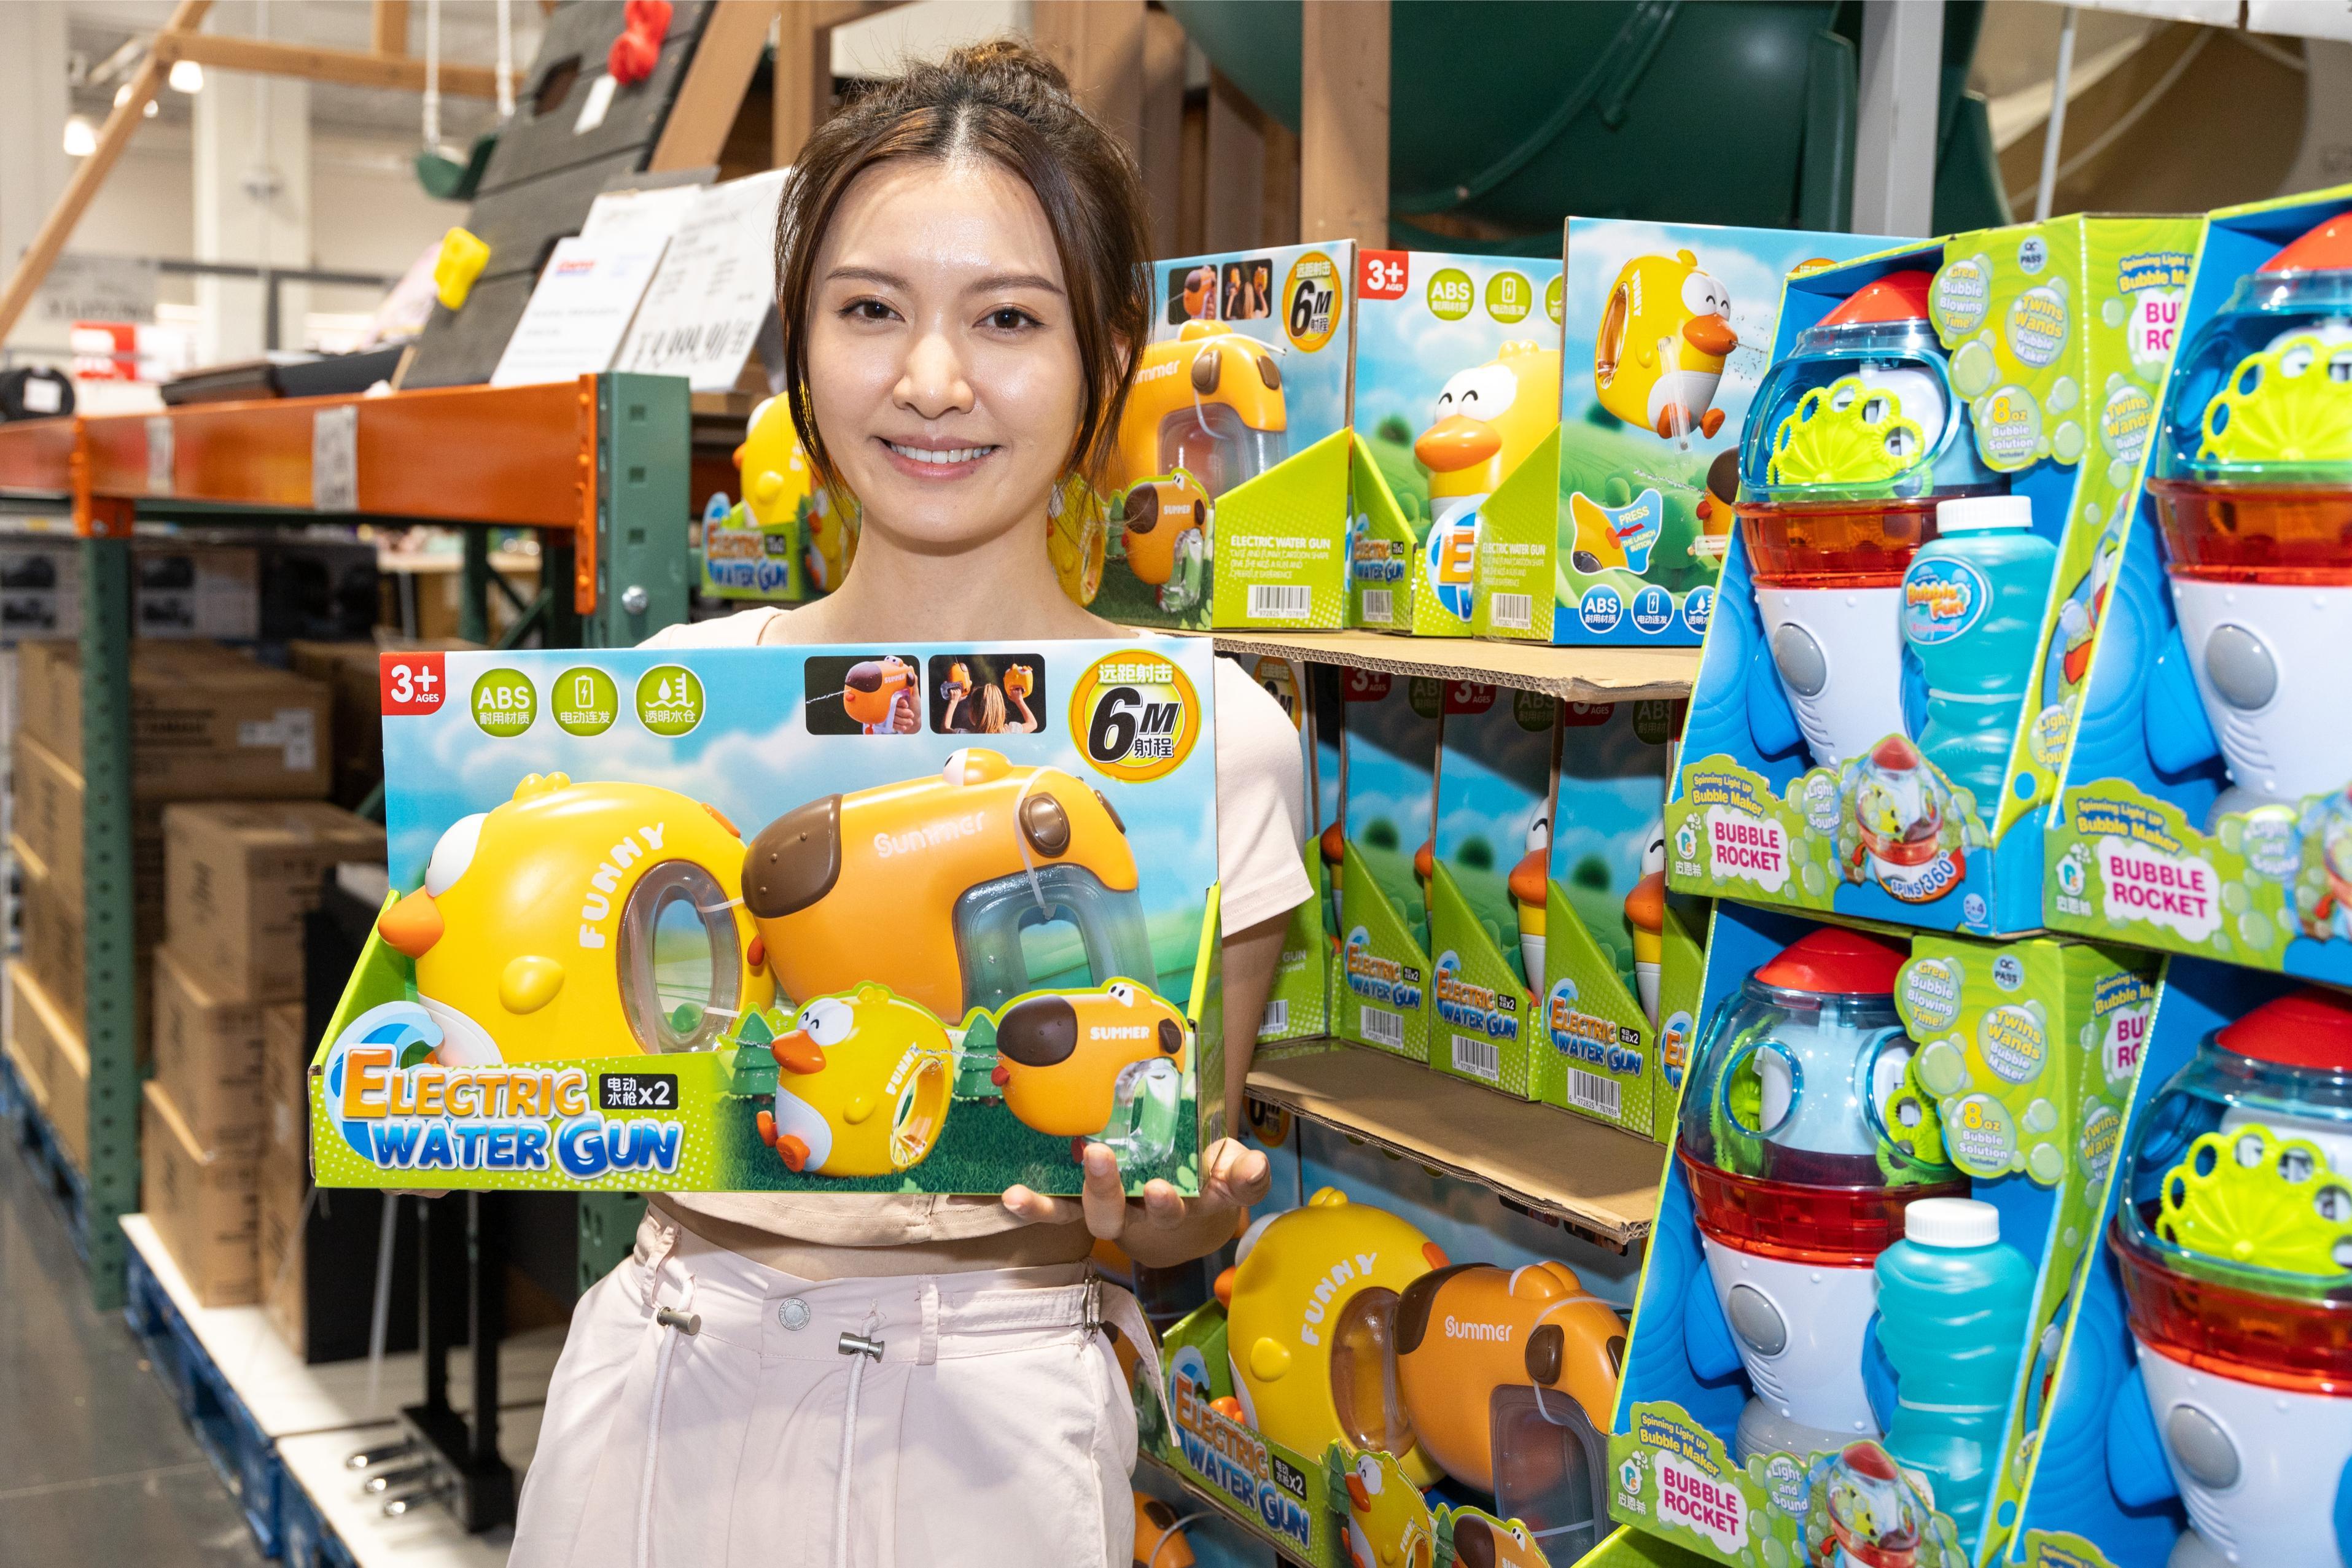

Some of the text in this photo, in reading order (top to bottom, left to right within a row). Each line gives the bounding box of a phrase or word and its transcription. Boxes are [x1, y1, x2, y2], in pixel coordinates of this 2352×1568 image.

[2024, 243, 2037, 252] QC
[2020, 254, 2042, 265] PASS
[2122, 254, 2185, 272] Spinning Light
[1367, 259, 1404, 290] 3+
[1951, 266, 1979, 279] Great
[1431, 281, 1470, 300] ABS
[1632, 269, 1641, 316] FUNNY
[1942, 282, 1983, 297] Bubble
[2119, 273, 2168, 293] Bubble
[1940, 298, 1982, 314] Blowing
[2023, 295, 2064, 322] Twins
[1944, 313, 1974, 328] Time!
[2015, 312, 2063, 338] Wands
[2017, 331, 2054, 350] Bubble
[2015, 345, 2049, 364] Maker
[1993, 398, 2027, 424] 8 oz
[2106, 398, 2148, 419] Twins
[1992, 425, 2030, 437] Bubble
[1989, 438, 2033, 449] Solution
[1164, 505, 1191, 515] SUMMER
[1619, 506, 1650, 525] PRESS
[1231, 535, 1331, 549] ELECTRIC WATER GUN
[1622, 529, 1656, 547] THE LAUNCH
[1630, 540, 1652, 553] BUTTON
[1483, 543, 1545, 555] ELECTRIC WATER GUN
[1907, 581, 1957, 605] Bubble
[1585, 598, 1617, 613] ABS
[1931, 598, 1965, 618] Fun
[1585, 615, 1616, 624] 耐用材质
[1637, 615, 1668, 624] 电动连发
[391, 664, 438, 703] 3+
[1097, 663, 1172, 684] 远距射击
[415, 694, 439, 702] AGES
[478, 686, 531, 710] ABS
[480, 712, 529, 724] 耐用材质
[560, 711, 610, 724] 电动连发
[645, 710, 695, 723] 透明水仓
[1134, 740, 1174, 758] 射程
[1693, 774, 1723, 789] Spinning
[1724, 778, 1743, 789] Light
[1809, 786, 1834, 799] Light
[1692, 790, 1764, 817] Bubble Maker
[1815, 802, 1831, 813] and
[2078, 800, 2146, 820] Spinning Light
[1809, 813, 1840, 829] Sound
[873, 812, 986, 858] Summer
[1715, 821, 1779, 850] BUBBLE
[2078, 817, 2181, 853] Bubble Maker
[1716, 844, 1782, 872] ROCKET
[1675, 861, 1702, 877] 皮恩希
[2111, 855, 2205, 893] BUBBLE
[580, 822, 664, 949] FUNNY
[1891, 879, 1923, 896] SPINS
[2112, 882, 2208, 918] ROCKET
[1283, 950, 1306, 961] GUN
[1348, 944, 1401, 982] ELECTRIC
[2000, 960, 2014, 969] QC
[1918, 962, 1951, 981] Great
[1995, 971, 2018, 983] PASS
[1352, 977, 1422, 1009] WATER GUN
[1436, 969, 1495, 1011] ELECTRIC
[1910, 976, 1953, 999] Bubble
[2096, 976, 2129, 995] Spinning
[1907, 990, 1953, 1016] Blowing
[2095, 991, 2138, 1014] Bubble
[1443, 1001, 1518, 1039] WATER GUN
[1551, 997, 1638, 1044] ELECTRIC x2
[1912, 1007, 1944, 1027] Time!
[1996, 1011, 2041, 1042] Twins
[1089, 1027, 1150, 1041] SUMMER
[1988, 1023, 2041, 1060] Wands
[1558, 1031, 1605, 1064] WATER
[1607, 1043, 1642, 1076] GUN
[1990, 1042, 2031, 1069] Bubble
[886, 1042, 921, 1096] FUNNY
[1460, 1063, 1476, 1073] 972825
[1480, 1068, 1495, 1079] 707898
[1988, 1056, 2025, 1081] Maker
[1577, 1098, 1595, 1109] 972825
[1599, 1105, 1617, 1116] 707898
[1964, 1103, 2001, 1131] 8 oz
[1963, 1130, 2004, 1144] Bubble
[2084, 1116, 2119, 1141] Twins
[372, 1119, 678, 1174] WATER GUN
[1959, 1143, 2008, 1159] Solution
[2084, 1130, 2117, 1159] Wand
[1301, 1252, 1378, 1346] FUNNY
[1445, 1315, 1513, 1342] Summer
[1175, 1374, 1269, 1480] ELECTRIC
[1641, 1414, 1675, 1434] Spinning
[1675, 1426, 1696, 1442] Light
[1640, 1429, 1720, 1476] Bubble Maker
[1771, 1463, 1802, 1482] Light
[1185, 1434, 1310, 1549] WATER GUN
[1289, 1477, 1304, 1496] x2
[1663, 1466, 1737, 1514] BUBBLE
[1779, 1483, 1797, 1496] and
[1618, 1491, 1647, 1515] 皮恩希
[1665, 1488, 1739, 1536] ROCKET
[1772, 1495, 1809, 1513] Sound
